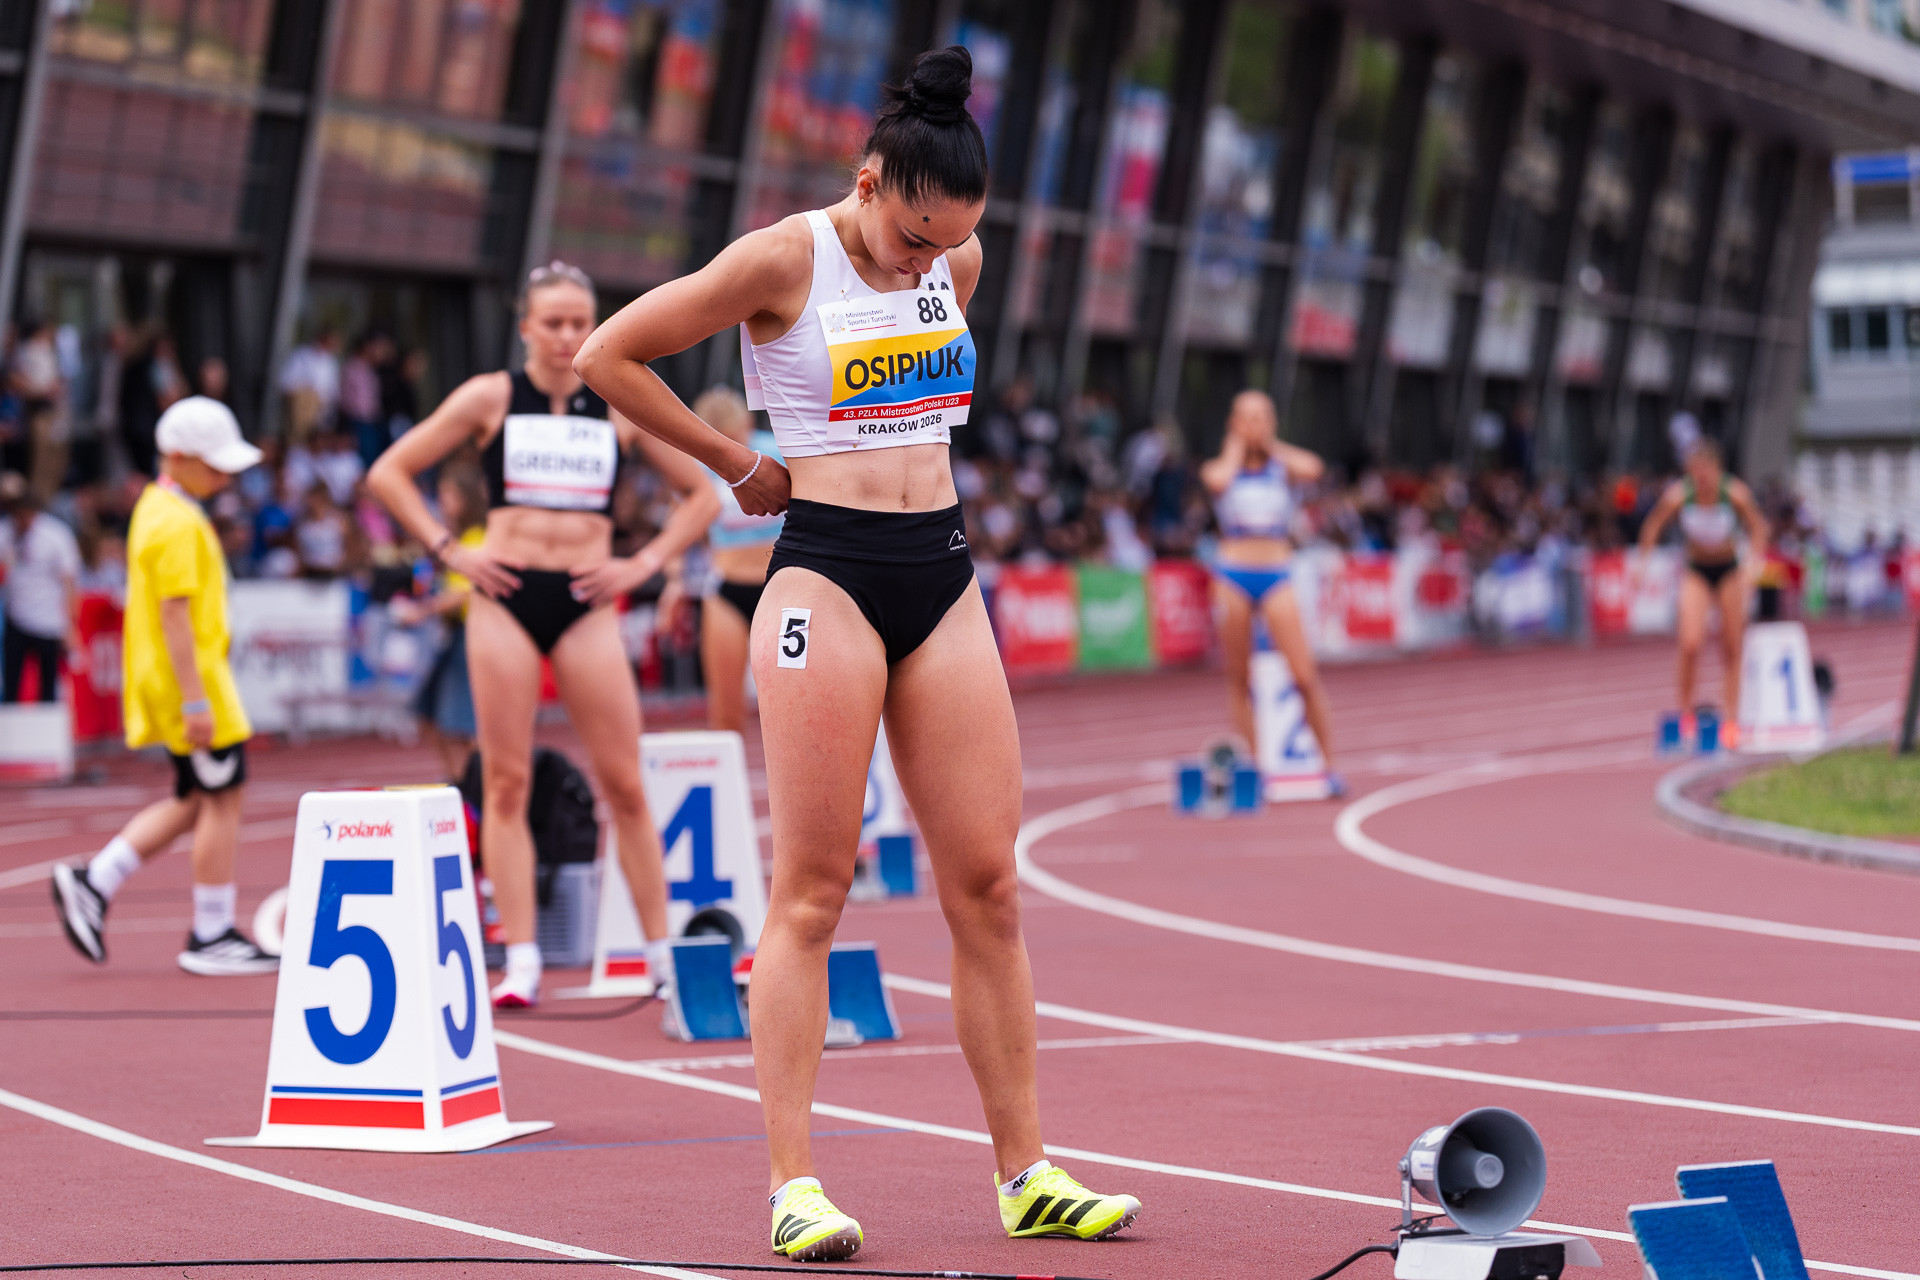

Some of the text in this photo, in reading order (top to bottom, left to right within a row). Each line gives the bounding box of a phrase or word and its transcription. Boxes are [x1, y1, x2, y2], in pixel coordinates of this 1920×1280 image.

[845, 309, 884, 319] Ministerstwo
[871, 313, 897, 323] Turystyki
[917, 296, 948, 324] 88
[844, 345, 964, 391] OSIPIUK
[843, 397, 960, 419] 43. PZLA Mistrzostwa Polski U23
[858, 413, 942, 435] KRAKÓW 2026
[511, 449, 606, 478] GREINER
[782, 618, 807, 659] 5
[1778, 655, 1799, 716] 1
[337, 819, 394, 842] polanik
[661, 785, 733, 913] 4
[304, 859, 397, 1065] 5
[433, 854, 476, 1060] 5
